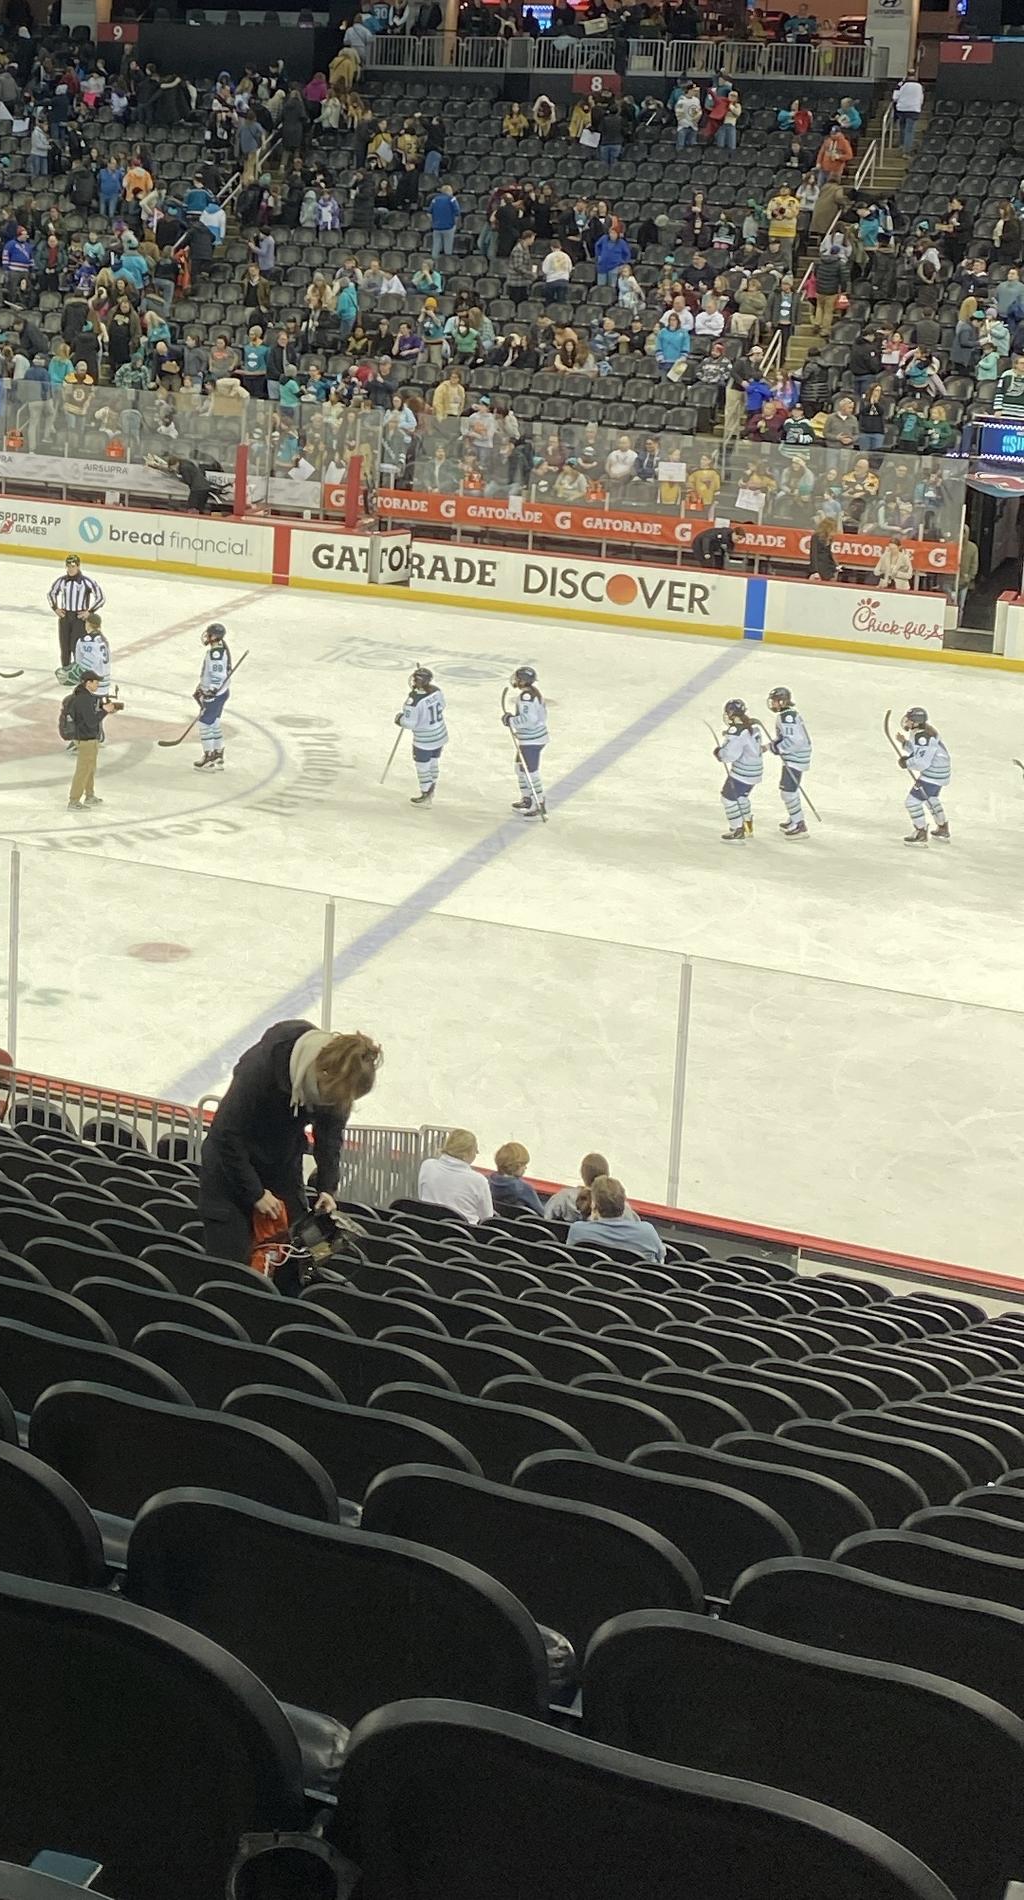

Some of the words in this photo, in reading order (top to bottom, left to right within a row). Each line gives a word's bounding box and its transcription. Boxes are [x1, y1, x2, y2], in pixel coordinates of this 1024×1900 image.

[112, 25, 123, 41] 9
[961, 45, 973, 61] 7
[590, 76, 602, 92] 8
[84, 464, 128, 474] AIRSUPRA
[40, 516, 61, 527] APP
[15, 525, 47, 536] GAMES
[109, 525, 165, 546] bread
[440, 500, 456, 518] G
[467, 505, 543, 523] GATORADE
[555, 511, 572, 529] G
[583, 517, 662, 536] GATORADE
[674, 523, 692, 542] G
[928, 548, 947, 567] G
[523, 563, 710, 615] DISCOVER
[38, 818, 242, 850] Center
